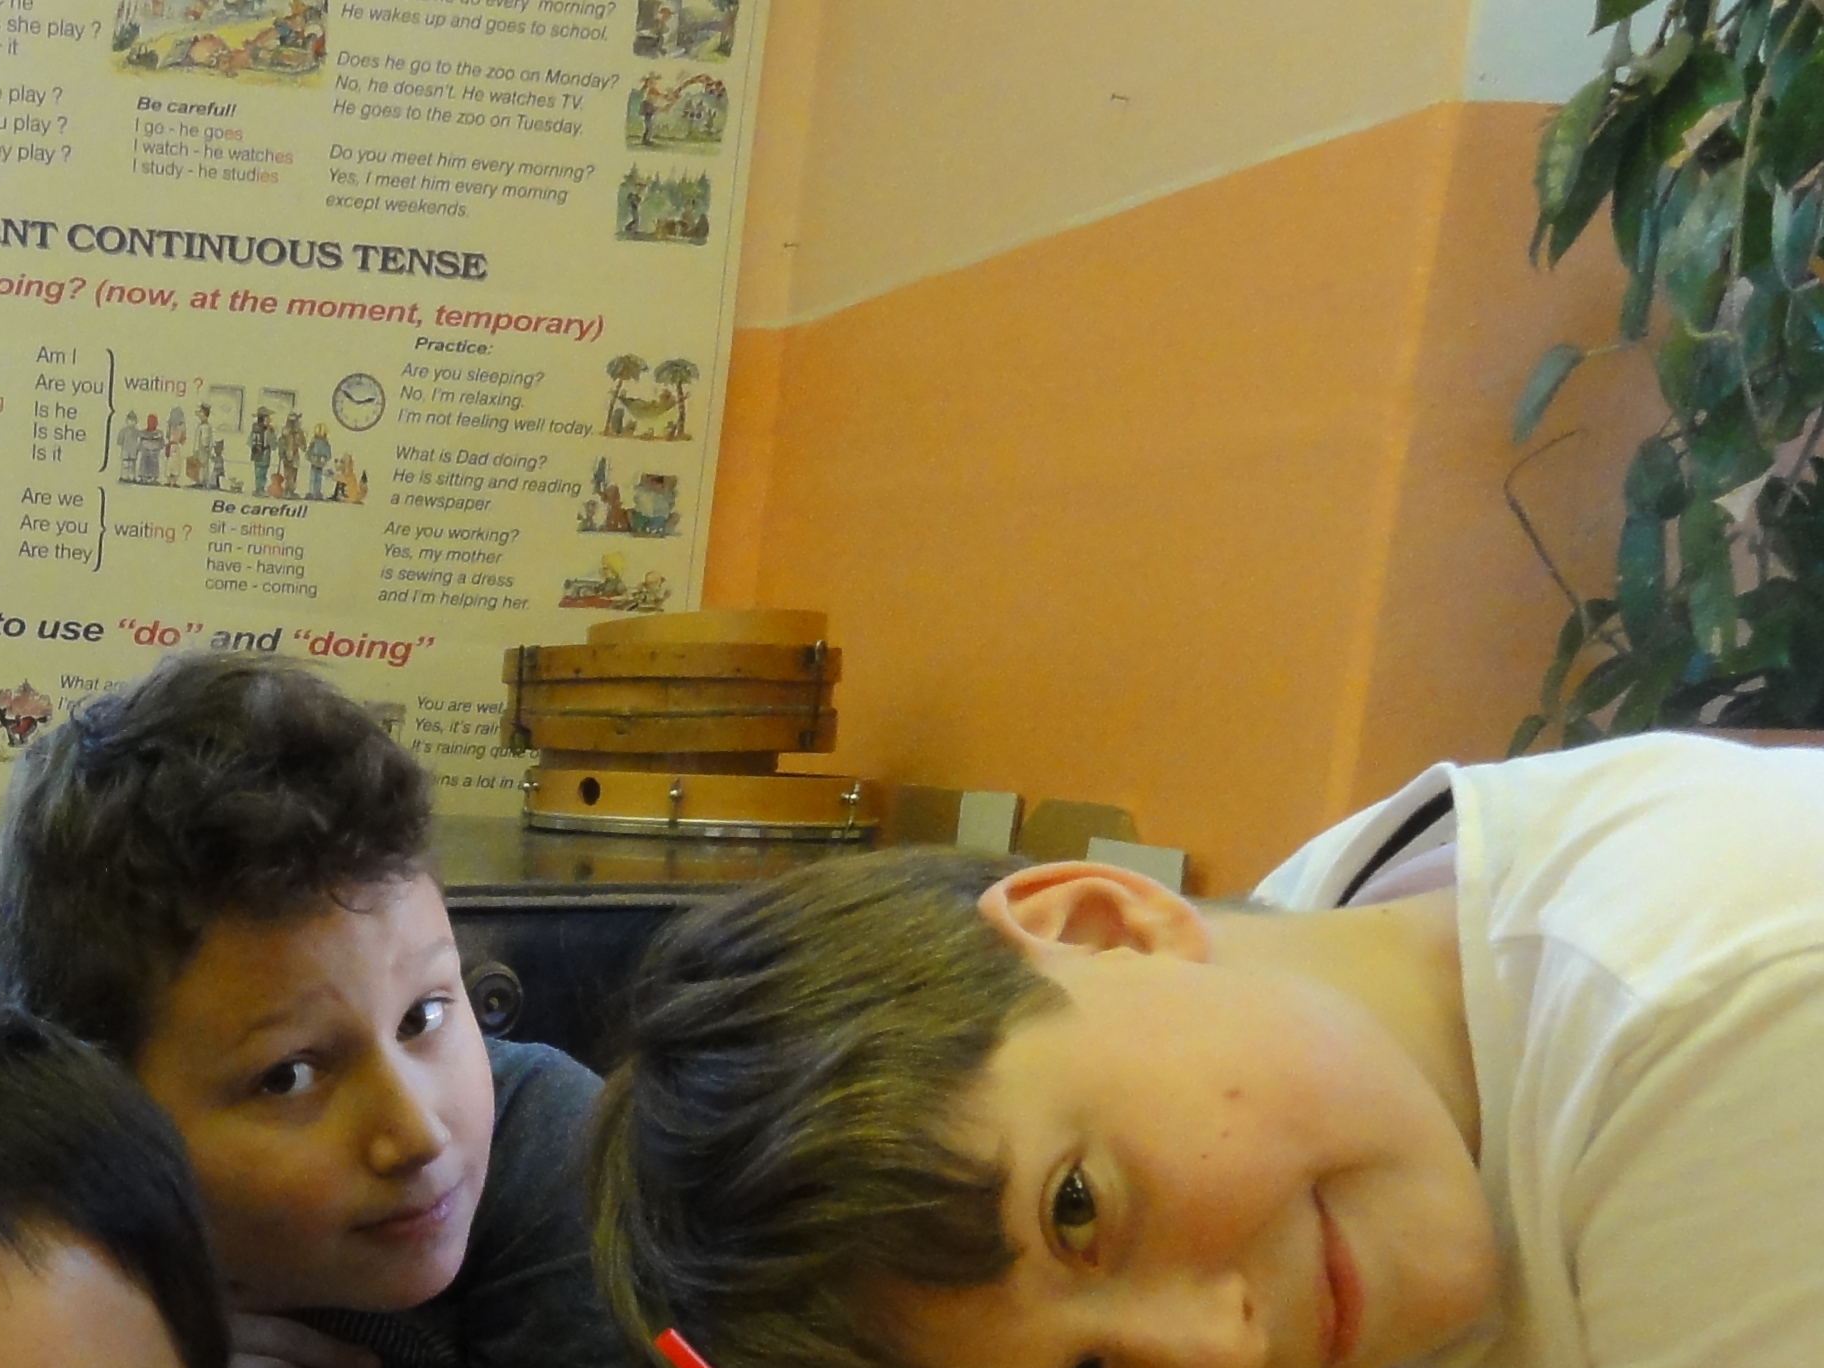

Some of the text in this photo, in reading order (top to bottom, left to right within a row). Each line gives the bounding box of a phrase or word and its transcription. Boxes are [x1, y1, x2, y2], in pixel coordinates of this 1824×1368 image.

[67, 224, 344, 271] CONTINUOUS
[351, 244, 488, 282] TENSE
[95, 279, 178, 311] (now,
[190, 289, 221, 310] at
[229, 289, 278, 314] the
[286, 299, 422, 328] moment,
[435, 305, 603, 342] temporary)
[125, 376, 186, 397] waiting
[114, 522, 175, 543] waiting
[37, 620, 104, 642] use
[210, 628, 283, 651] and
